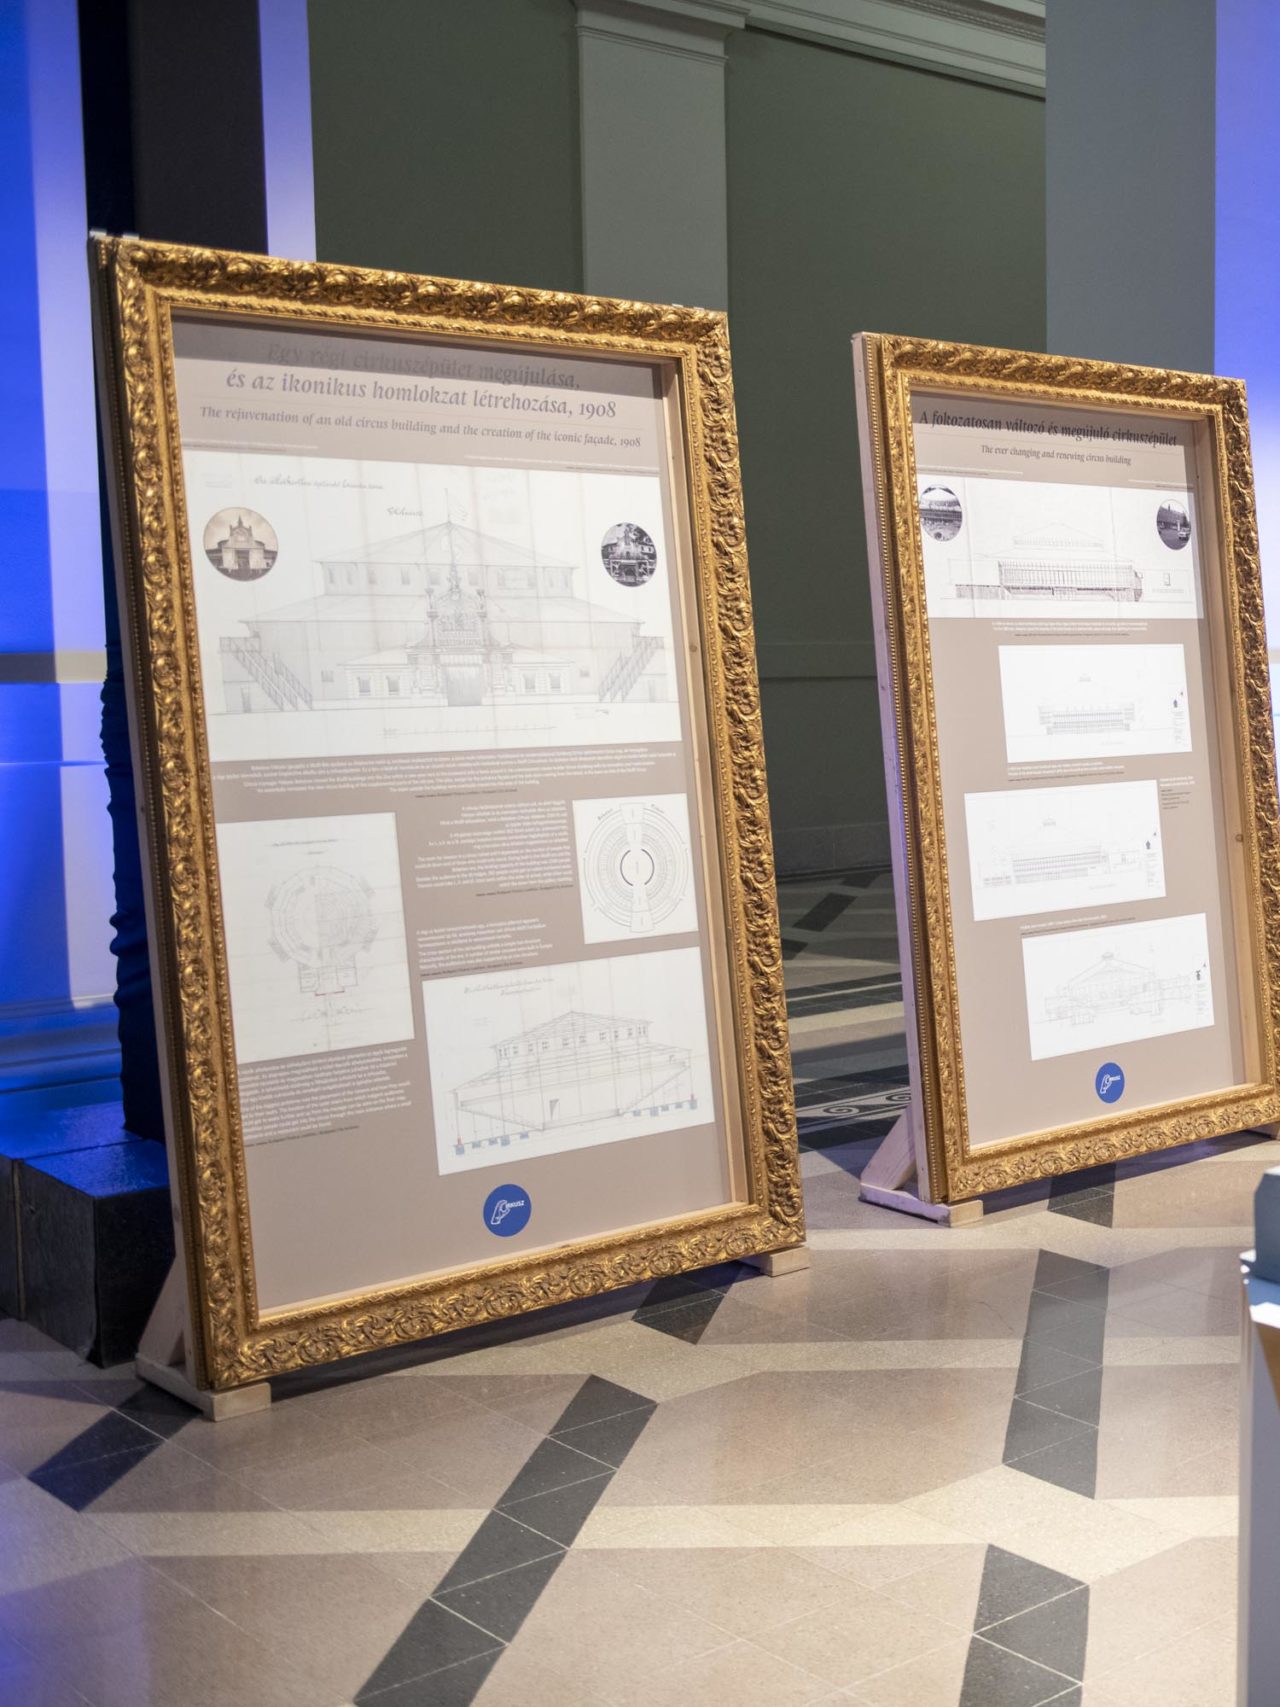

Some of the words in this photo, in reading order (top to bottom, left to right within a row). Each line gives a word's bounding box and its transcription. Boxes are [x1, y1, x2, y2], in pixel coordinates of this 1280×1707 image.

[226, 368, 246, 388] és
[251, 375, 275, 391] az
[281, 372, 367, 398] ikonikus
[372, 381, 467, 405] homlokzat
[473, 390, 573, 417] létrehozása,
[579, 400, 617, 420] 1908
[479, 365, 580, 389] megújulása,
[200, 406, 222, 418] The
[225, 409, 299, 423] rejuvenation
[302, 412, 314, 426] of
[316, 416, 332, 425] an
[335, 416, 352, 428] old
[355, 417, 388, 430] circus
[391, 419, 437, 434] building
[439, 424, 460, 434] and
[463, 424, 479, 436] the
[481, 426, 522, 439] creation
[524, 429, 535, 441] of
[536, 430, 551, 441] the
[554, 431, 582, 444] iconic
[584, 433, 617, 447] façade,
[620, 437, 641, 448] 1908
[920, 410, 929, 424] A
[931, 410, 1002, 430] fokozatosan
[1006, 418, 1045, 434] változó
[1047, 421, 1059, 436] és
[1111, 427, 1177, 448] cirkuszépület
[981, 445, 993, 454] The
[1010, 447, 1041, 459] changing
[1042, 450, 1055, 459] and
[1056, 451, 1085, 463] renewing
[1086, 453, 1104, 463] circus
[1105, 454, 1132, 466] building
